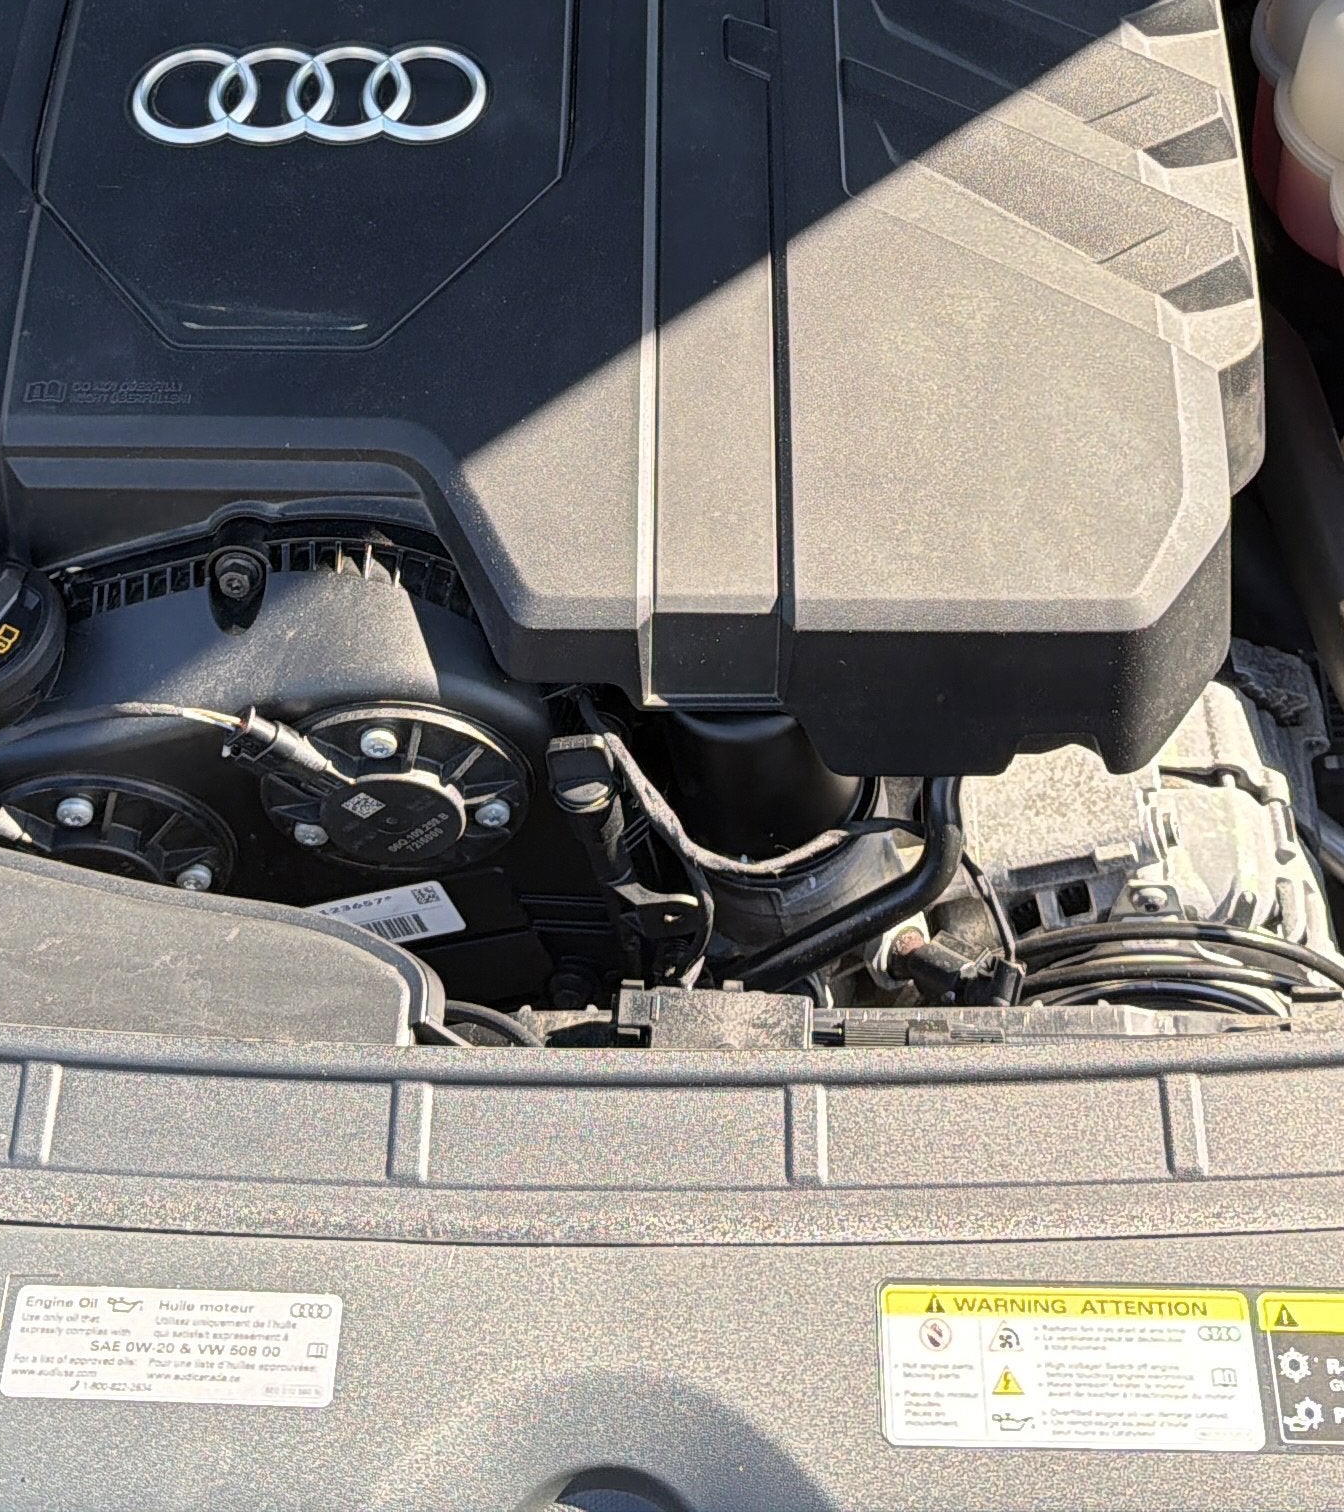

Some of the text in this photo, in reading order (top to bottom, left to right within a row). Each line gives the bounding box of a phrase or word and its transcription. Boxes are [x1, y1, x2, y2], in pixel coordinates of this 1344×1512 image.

[25, 1296, 98, 1309] Engine Oil
[159, 1299, 255, 1313] Huile moteur
[952, 1297, 1208, 1316] WARNING ATTENTION
[90, 1340, 281, 1357] SAE 0W-20 & VW 508 00
